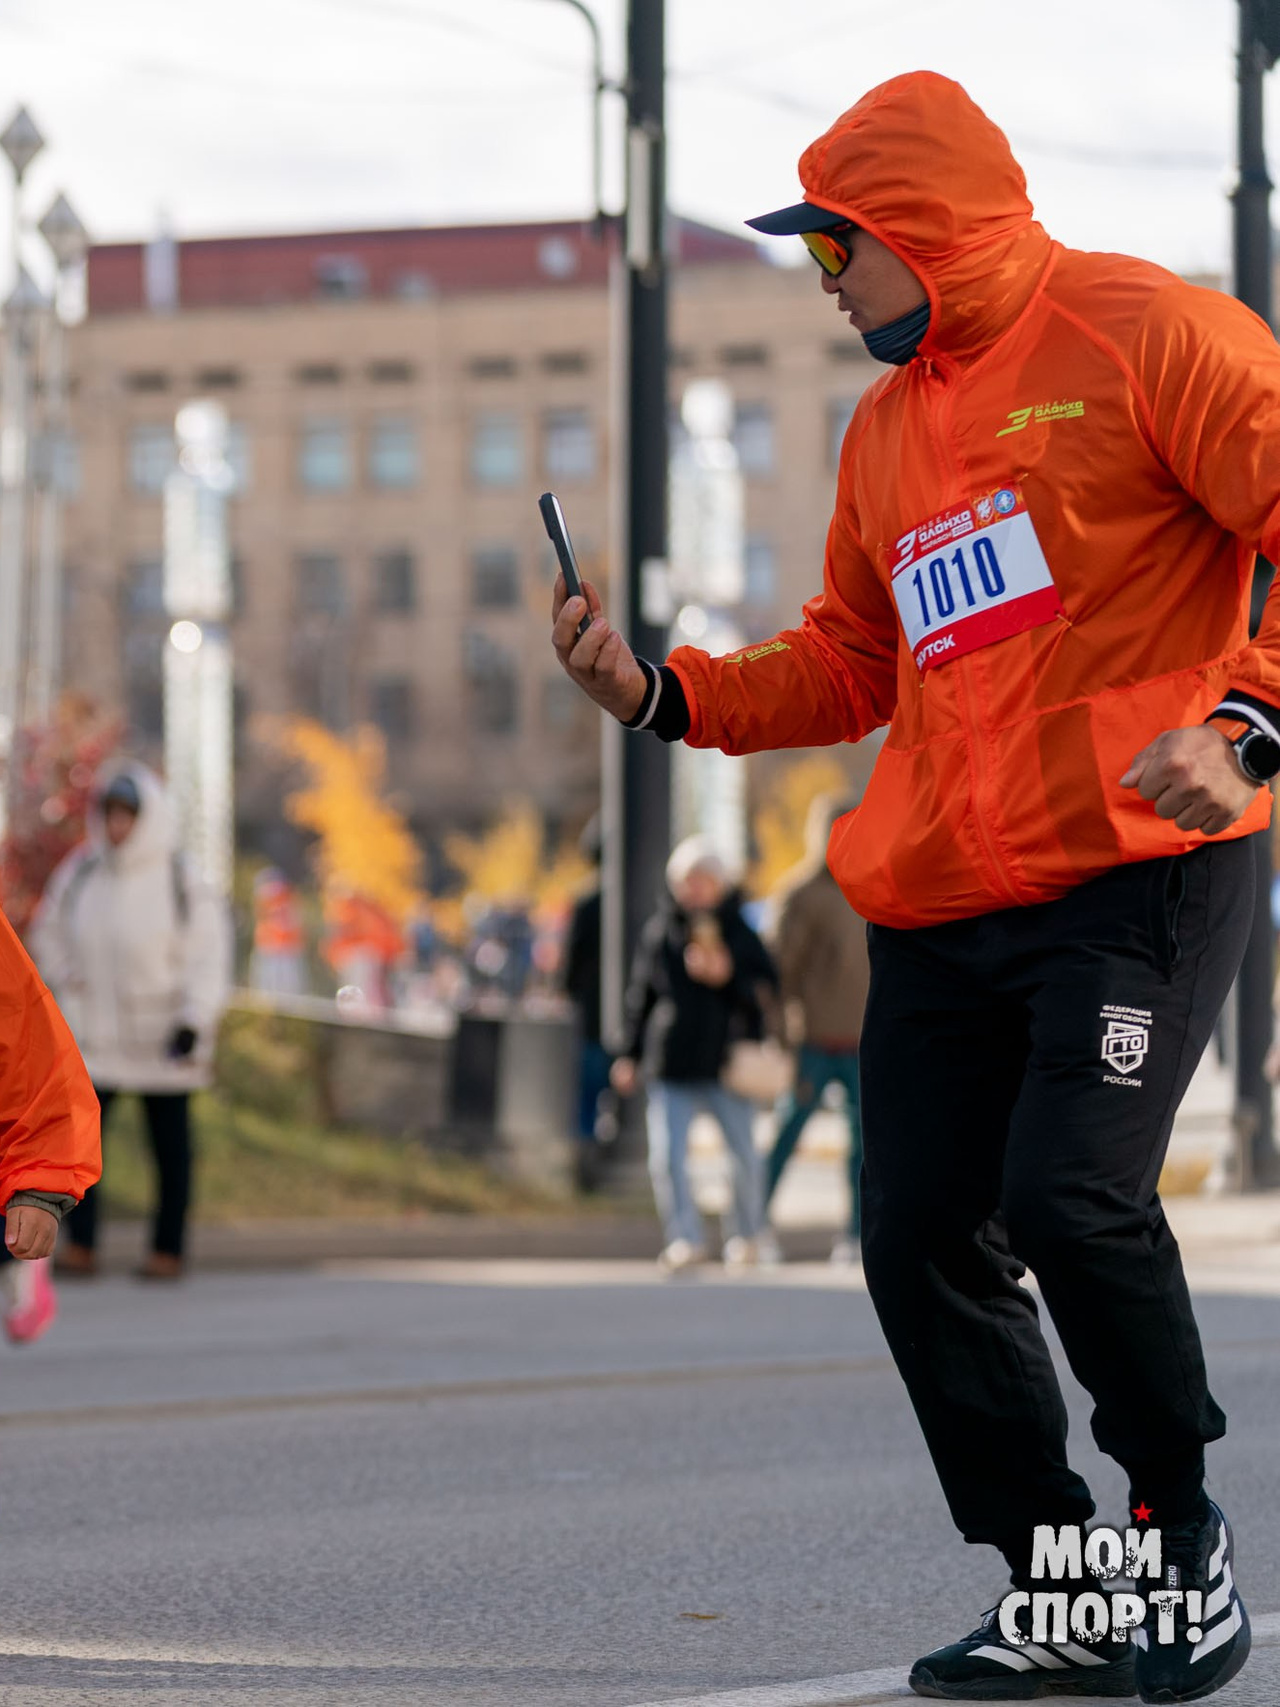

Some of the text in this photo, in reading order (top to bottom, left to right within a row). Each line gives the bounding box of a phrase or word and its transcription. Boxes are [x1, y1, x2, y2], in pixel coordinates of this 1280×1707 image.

[918, 510, 971, 543] ОЛОНХО
[912, 536, 1006, 628] 1010
[1108, 1036, 1143, 1053] ГТО
[1103, 1075, 1142, 1087] РОССИИ
